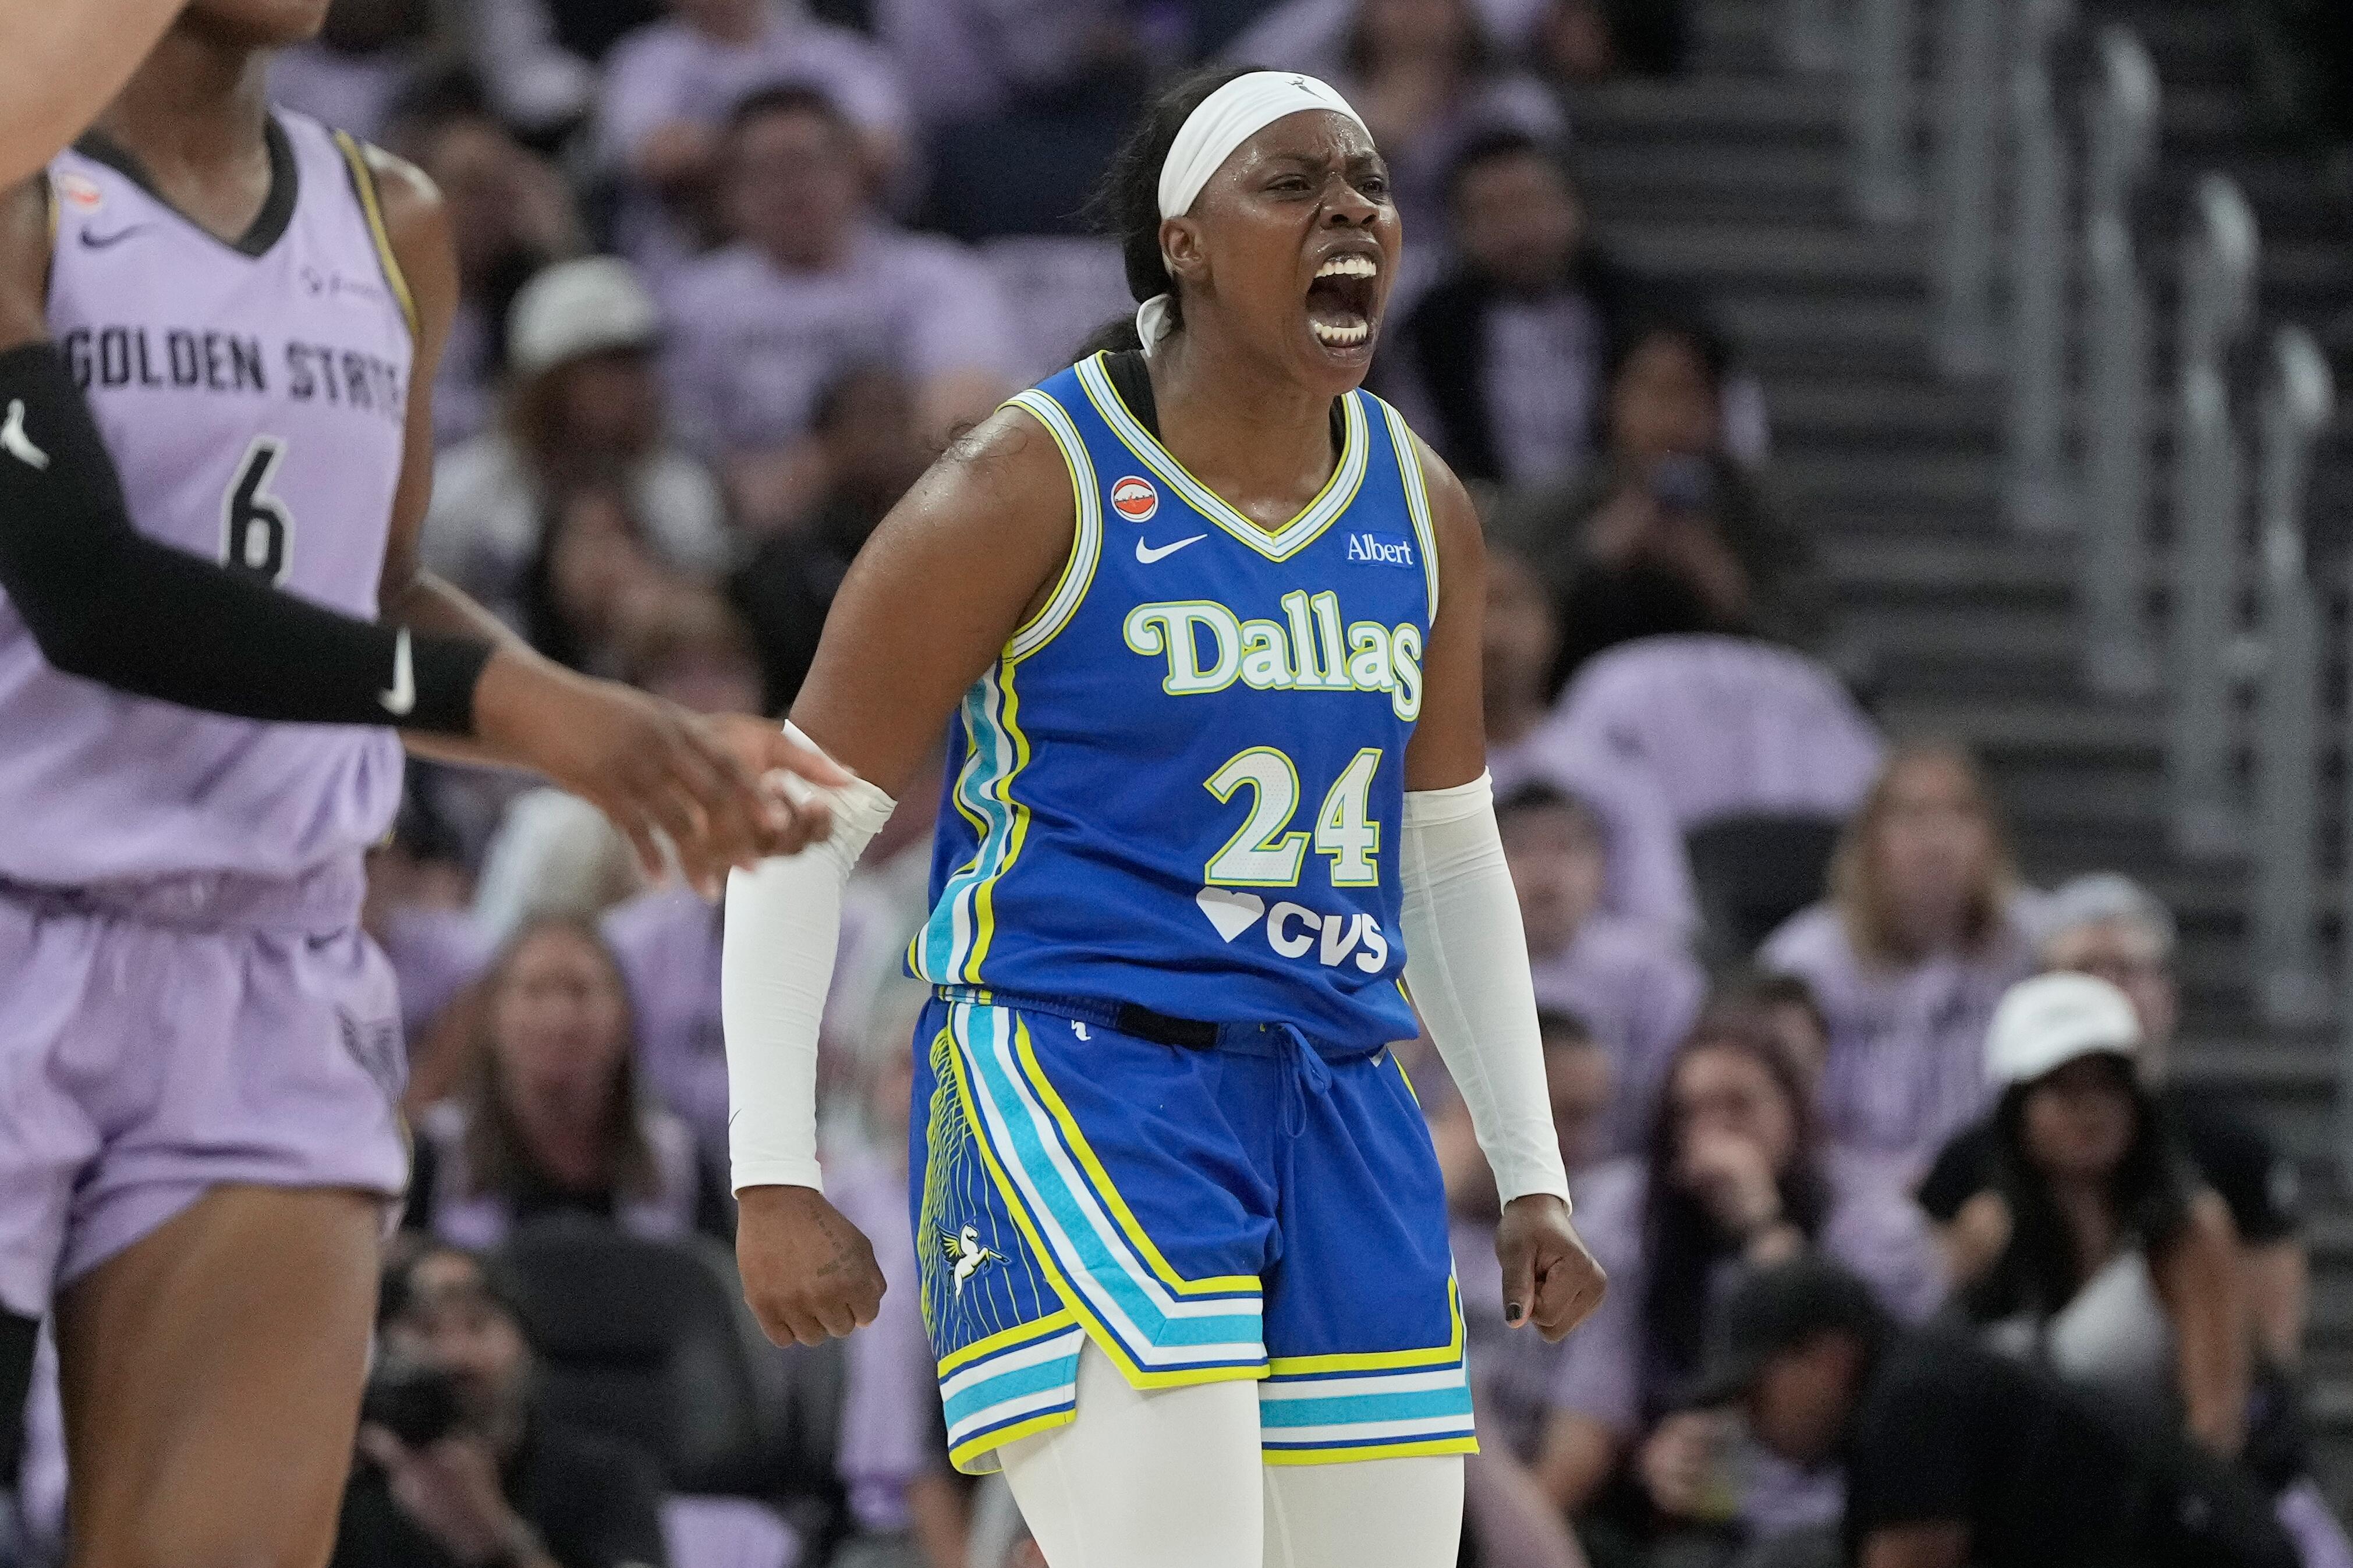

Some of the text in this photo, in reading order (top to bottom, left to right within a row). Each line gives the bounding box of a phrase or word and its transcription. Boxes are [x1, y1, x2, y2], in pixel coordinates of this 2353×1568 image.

[64, 325, 268, 392] GOLDEN
[220, 434, 294, 589] 6
[1347, 533, 1413, 565] Albert
[1122, 589, 1422, 722] Dallas
[1203, 746, 1383, 887] 24
[1267, 902, 1388, 974] CVS
